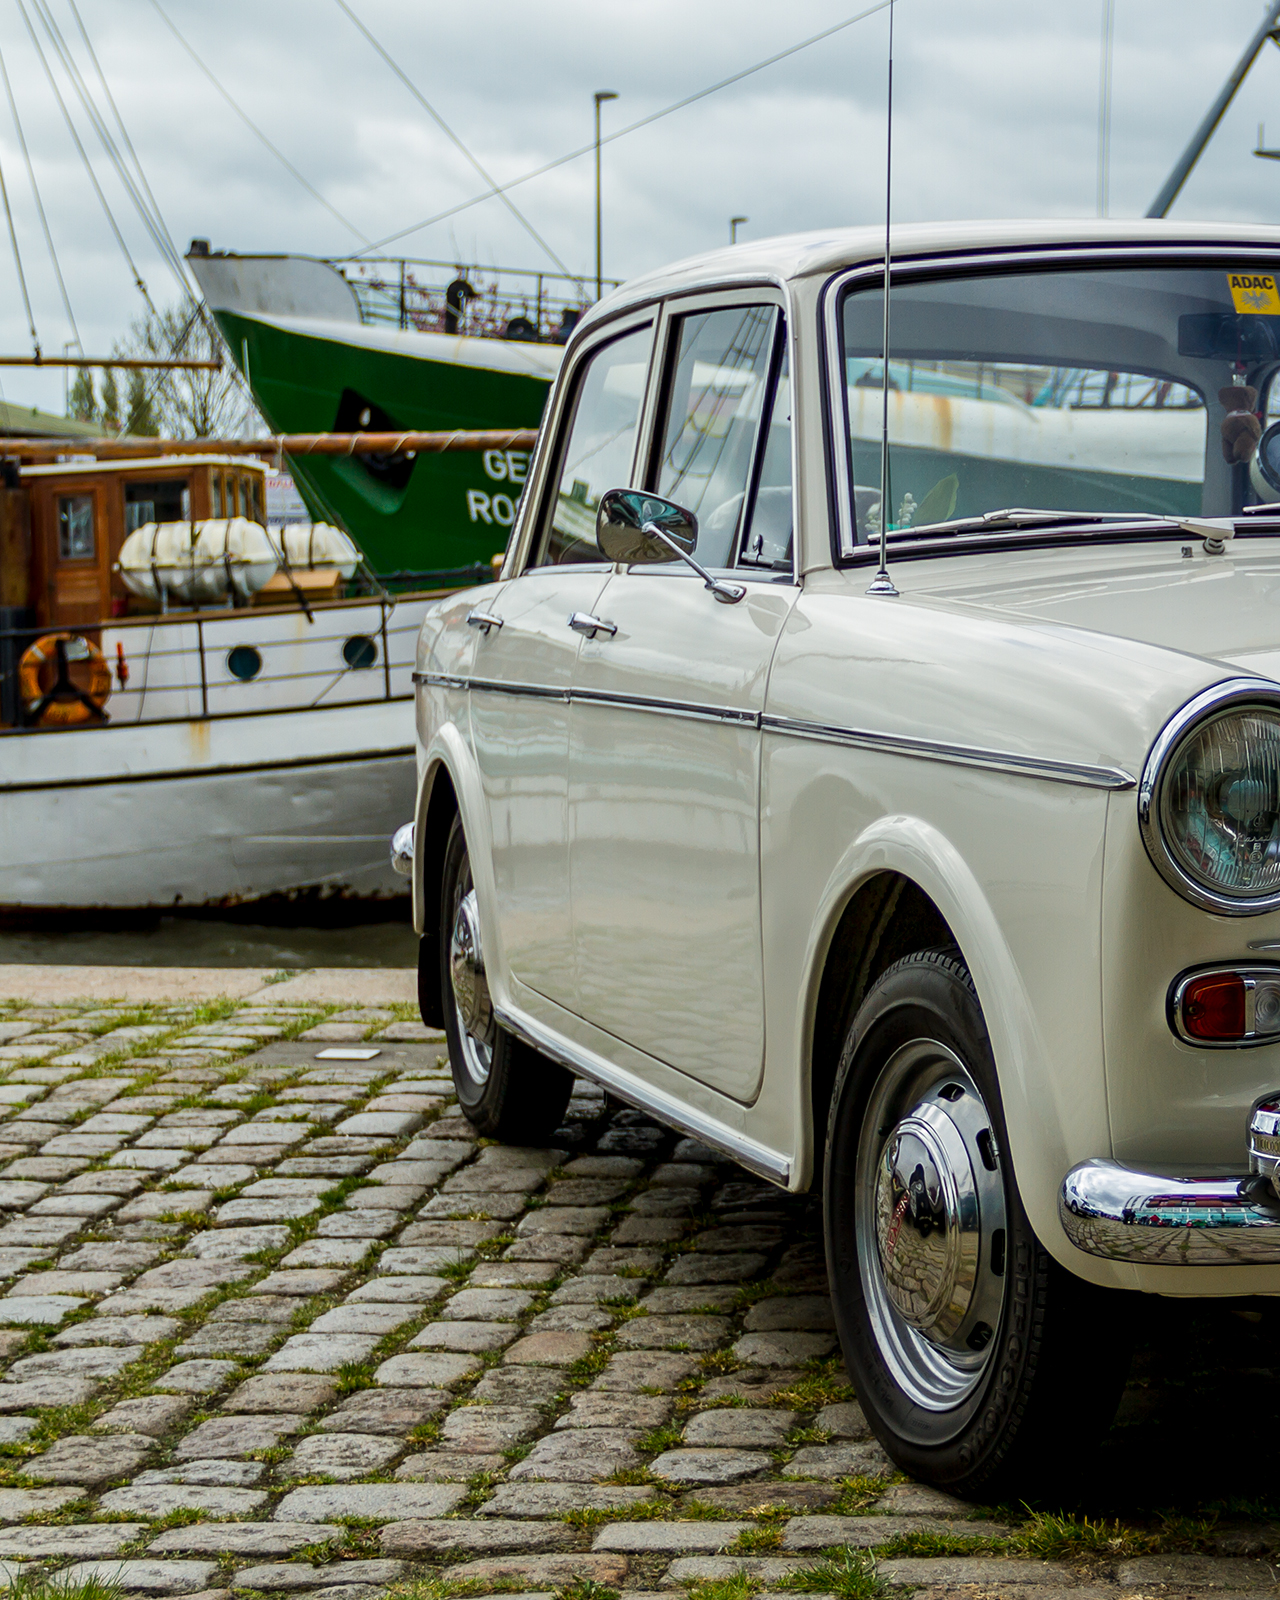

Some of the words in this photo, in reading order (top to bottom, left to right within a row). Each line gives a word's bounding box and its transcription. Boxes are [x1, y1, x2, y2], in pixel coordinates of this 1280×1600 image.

[1231, 275, 1274, 290] ADAC
[483, 449, 534, 484] GE
[466, 488, 521, 527] RO
